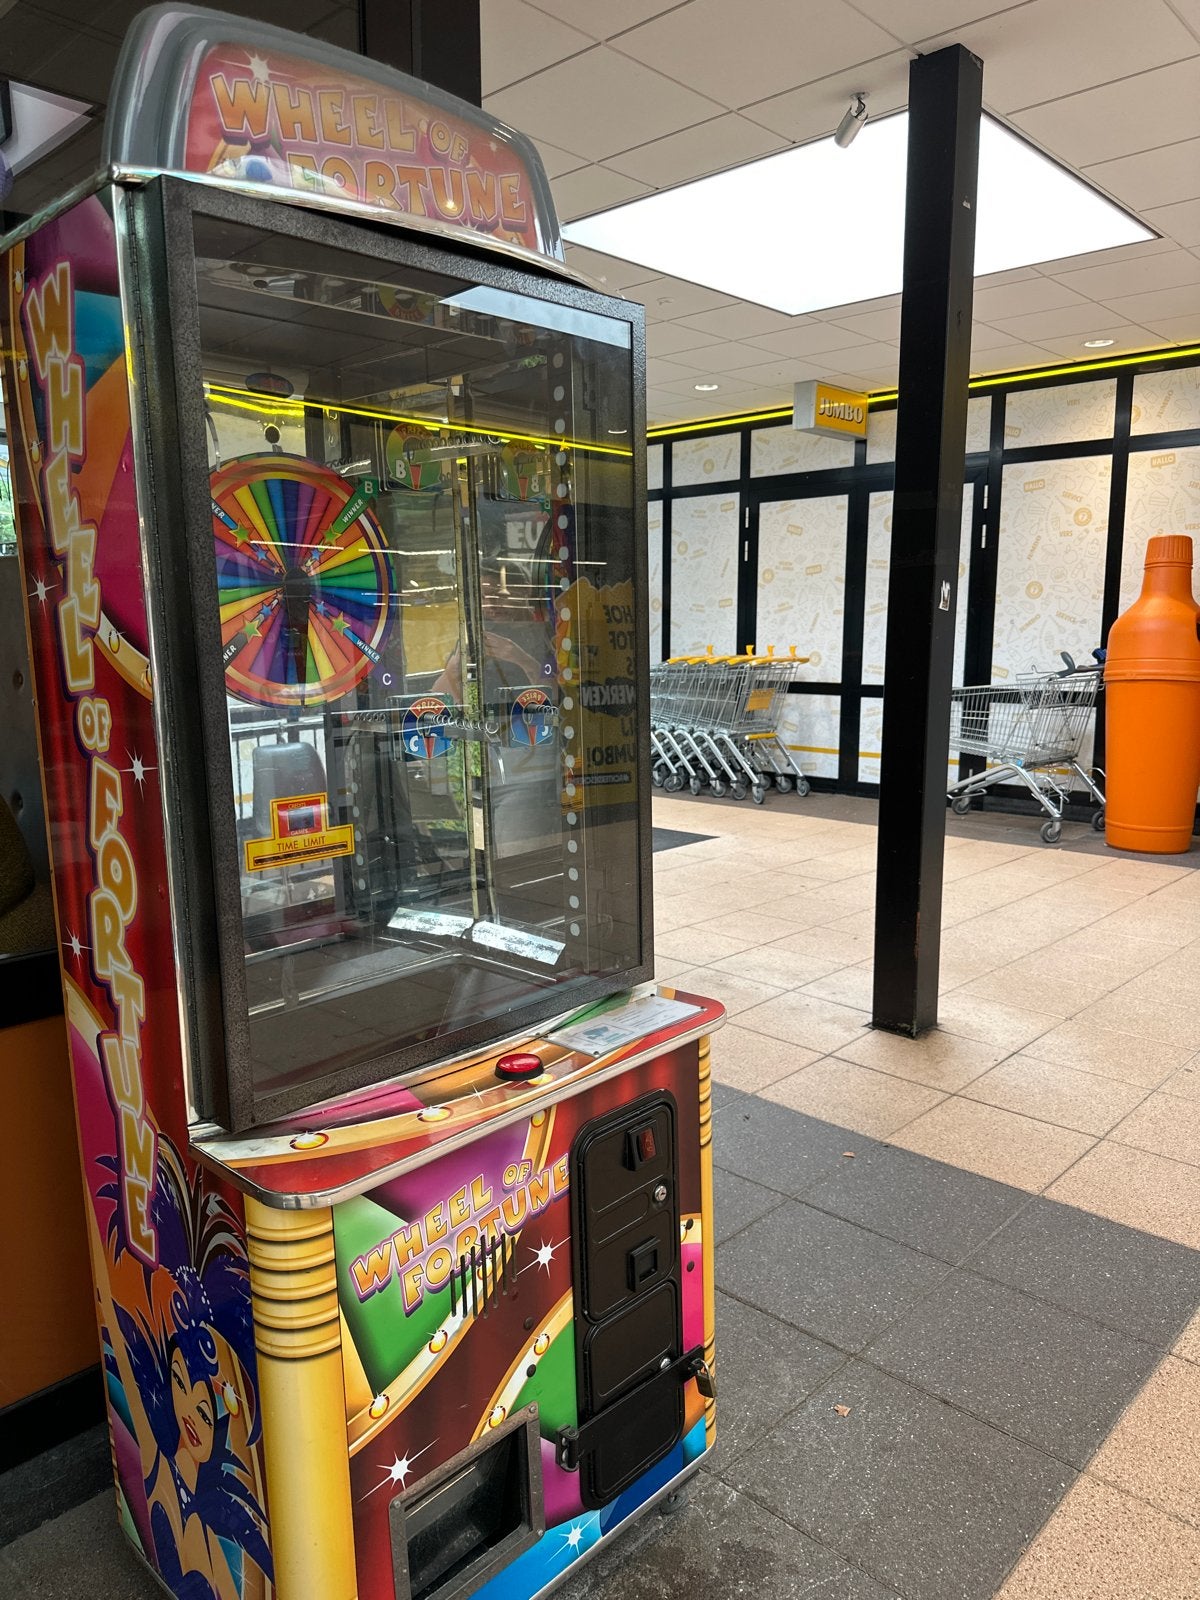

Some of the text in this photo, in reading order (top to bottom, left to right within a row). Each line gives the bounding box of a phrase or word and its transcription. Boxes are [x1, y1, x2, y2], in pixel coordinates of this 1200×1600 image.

[209, 72, 469, 164] WHEEL OF
[285, 152, 528, 222] FORTUNE
[818, 397, 865, 425] JUMBO
[395, 459, 407, 479] B
[1151, 455, 1175, 466] HALLO
[364, 480, 374, 494] B
[1024, 480, 1045, 491] HALLO
[341, 498, 364, 524] WINNER
[355, 639, 382, 662] WINNER
[382, 673, 392, 686] C
[409, 735, 419, 752] C
[26, 261, 160, 1266] WHEEL OF FORTUNE
[277, 835, 327, 852] TIME LIMIT
[351, 1162, 532, 1295] WHEEL OF
[401, 1153, 570, 1312] FORTUNE
